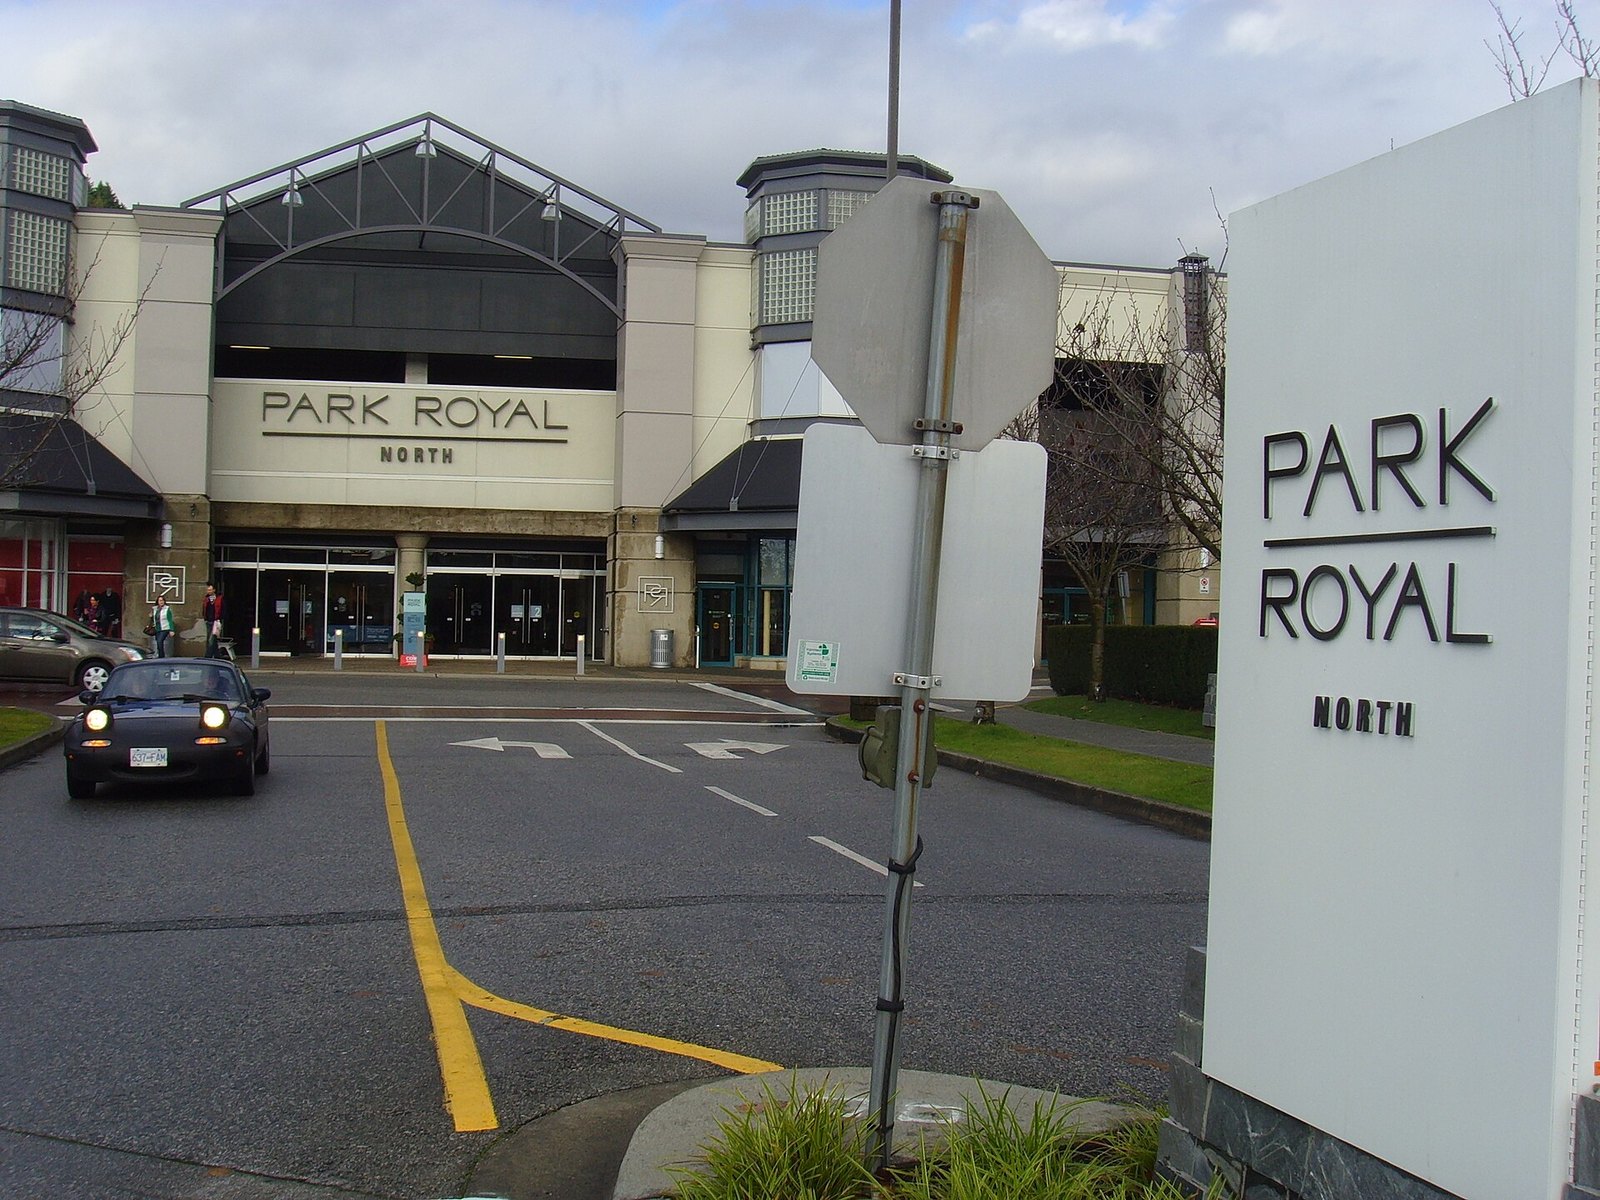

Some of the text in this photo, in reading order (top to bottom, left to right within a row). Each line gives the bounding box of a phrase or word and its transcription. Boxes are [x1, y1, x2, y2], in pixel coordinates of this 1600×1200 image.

[263, 391, 568, 430] PARK ROYAL
[380, 446, 453, 464] NORTH
[1262, 396, 1497, 519] PARK
[1259, 561, 1494, 644] ROYAL
[1313, 695, 1415, 737] NORTH
